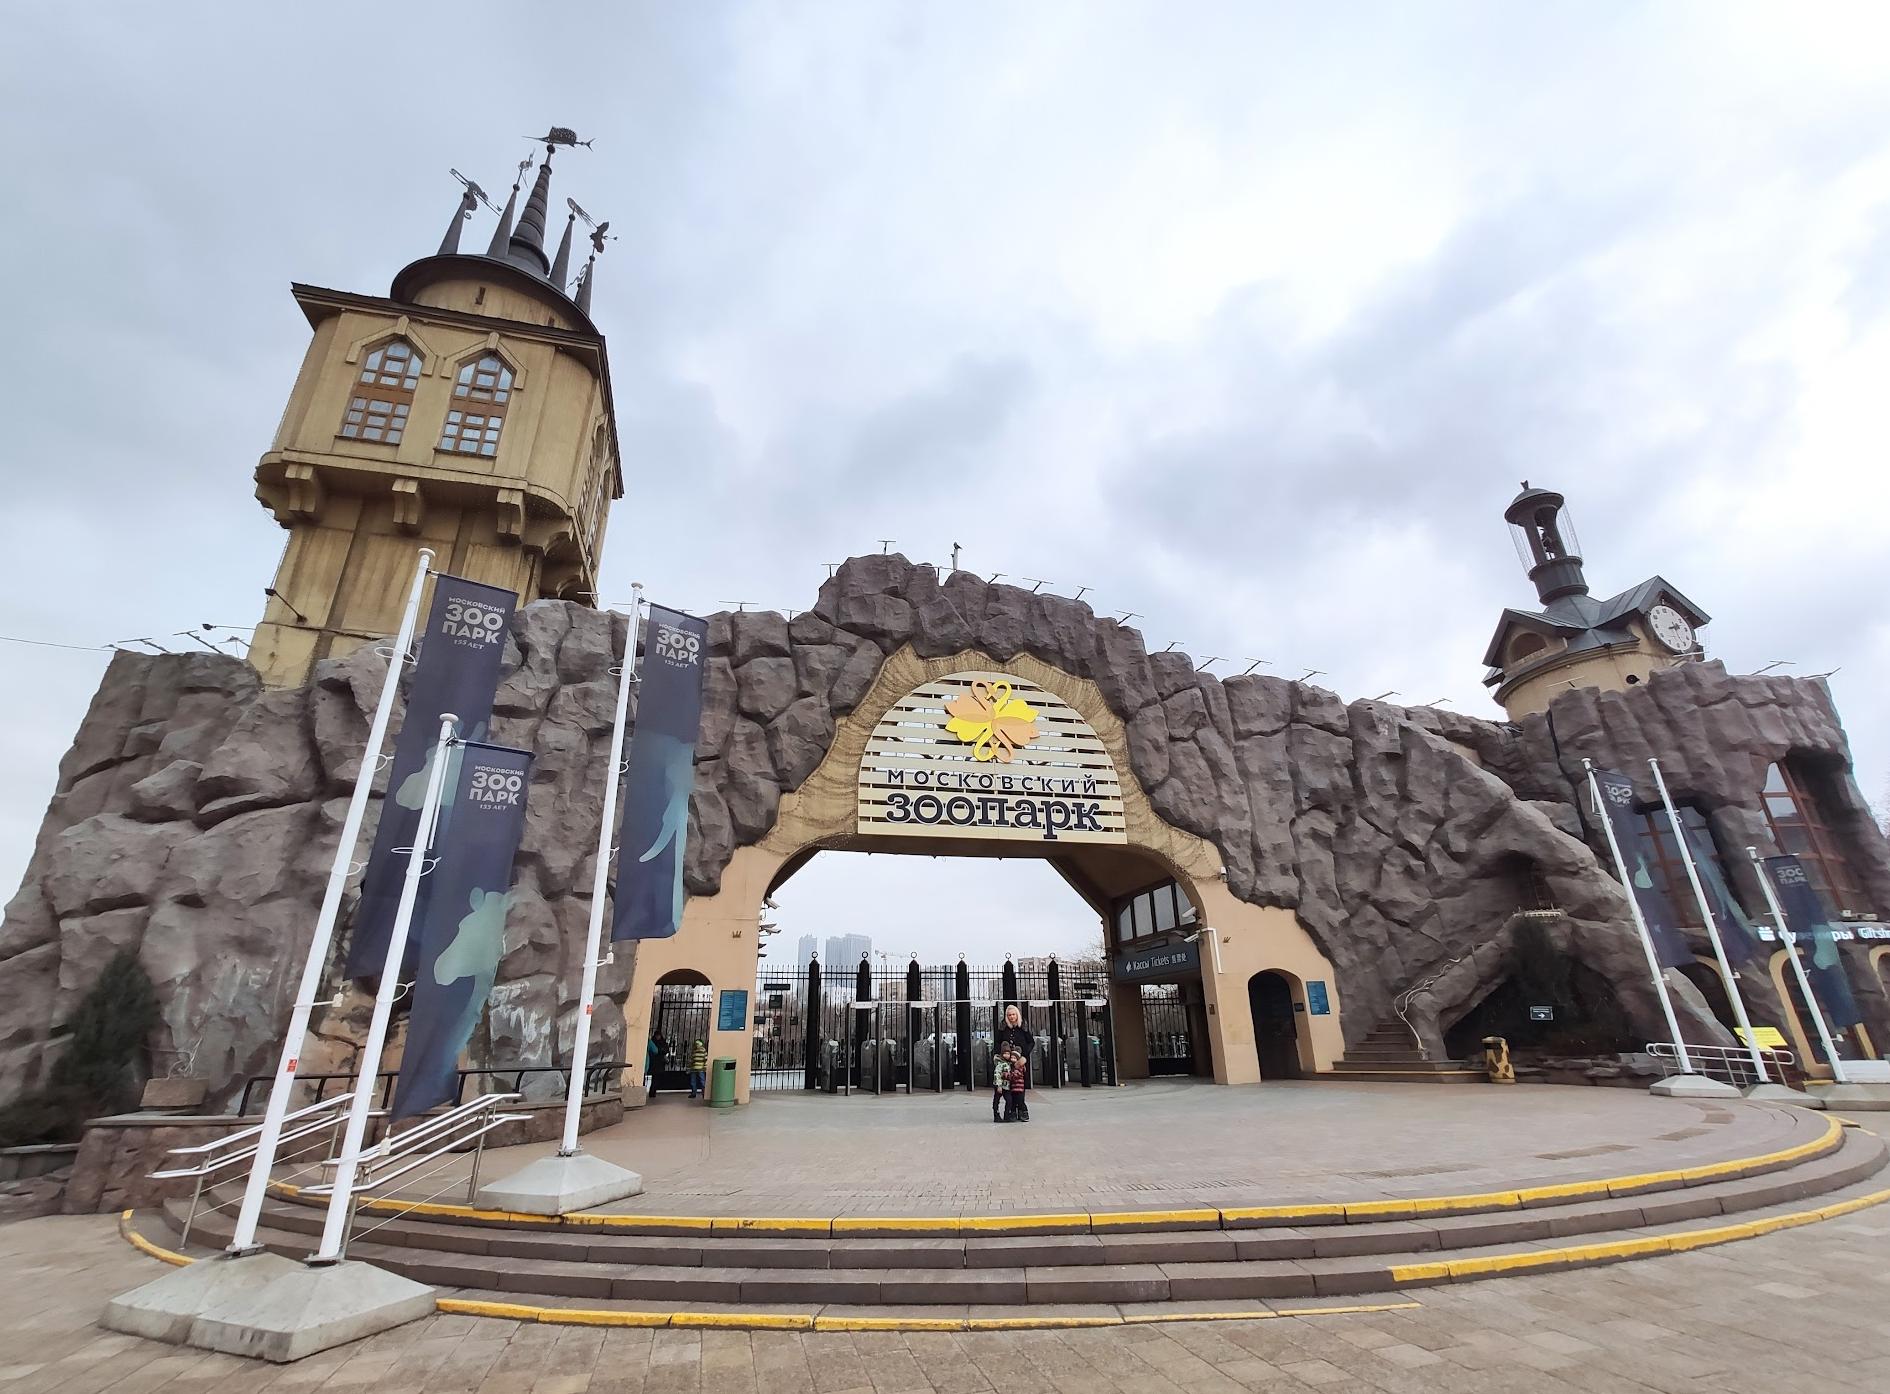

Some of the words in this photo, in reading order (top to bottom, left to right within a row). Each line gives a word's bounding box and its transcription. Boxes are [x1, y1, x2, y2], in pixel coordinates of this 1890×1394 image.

[448, 596, 506, 614] МОСКОВСКИЙ
[445, 603, 504, 631] ЗОО
[441, 620, 500, 644] ПАРК
[657, 629, 700, 653] ЗОО
[655, 642, 699, 665] ПАРК
[471, 771, 522, 792] ЗОО
[887, 769, 1097, 794] МОСКОВСКИЙ
[469, 787, 520, 805] ПАРК
[886, 792, 1104, 840] зоопарк
[1132, 960, 1149, 971] Кассы
[1150, 955, 1170, 967] Tickets
